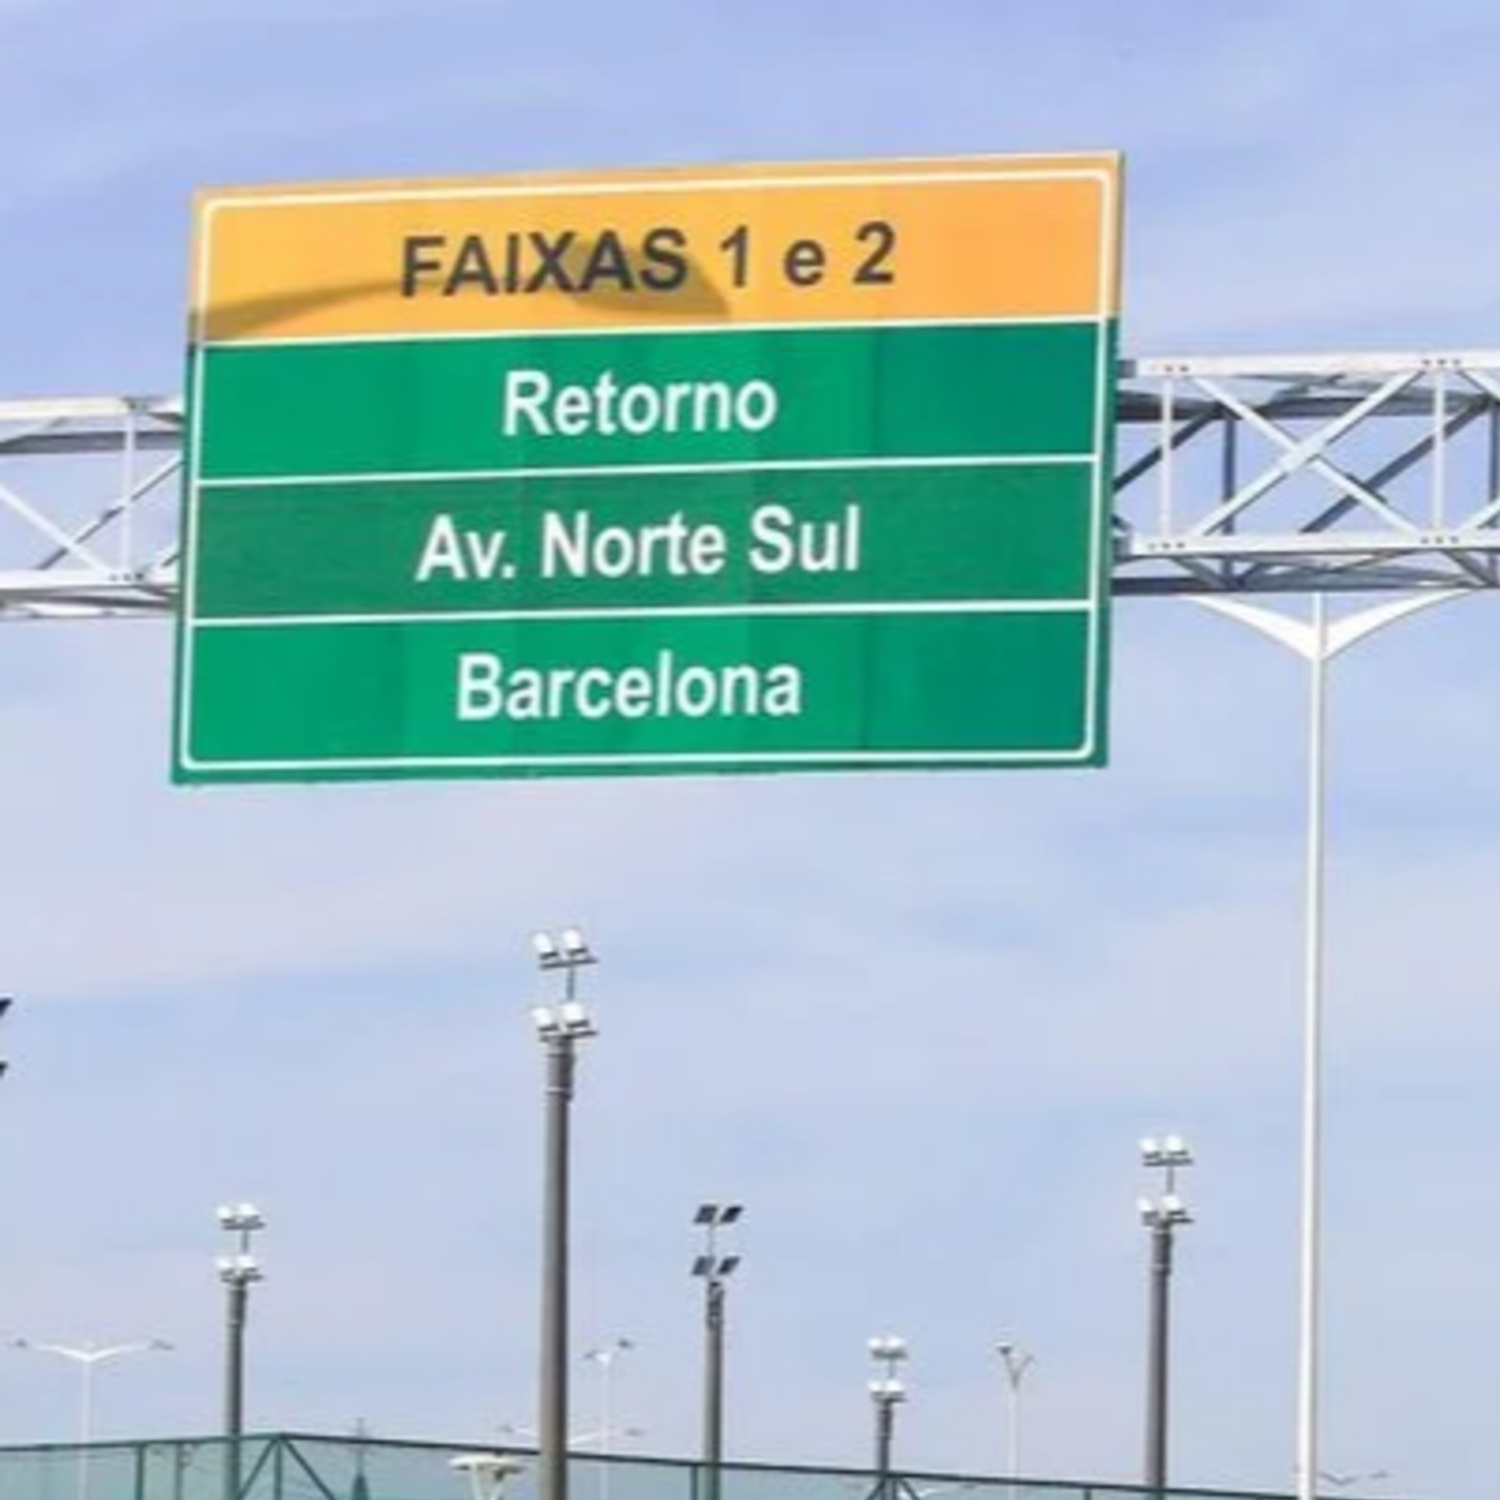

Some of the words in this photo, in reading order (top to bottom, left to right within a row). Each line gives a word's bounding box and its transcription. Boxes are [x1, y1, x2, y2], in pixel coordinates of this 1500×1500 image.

[400, 226, 692, 299] FAIXAS
[720, 224, 749, 288] 1
[782, 238, 826, 288] e
[853, 219, 896, 286] 2
[503, 368, 779, 437] Retorno
[415, 513, 517, 584] Av.
[540, 510, 728, 580] Norte
[748, 503, 861, 575] Sul
[456, 649, 802, 722] Barcelona
